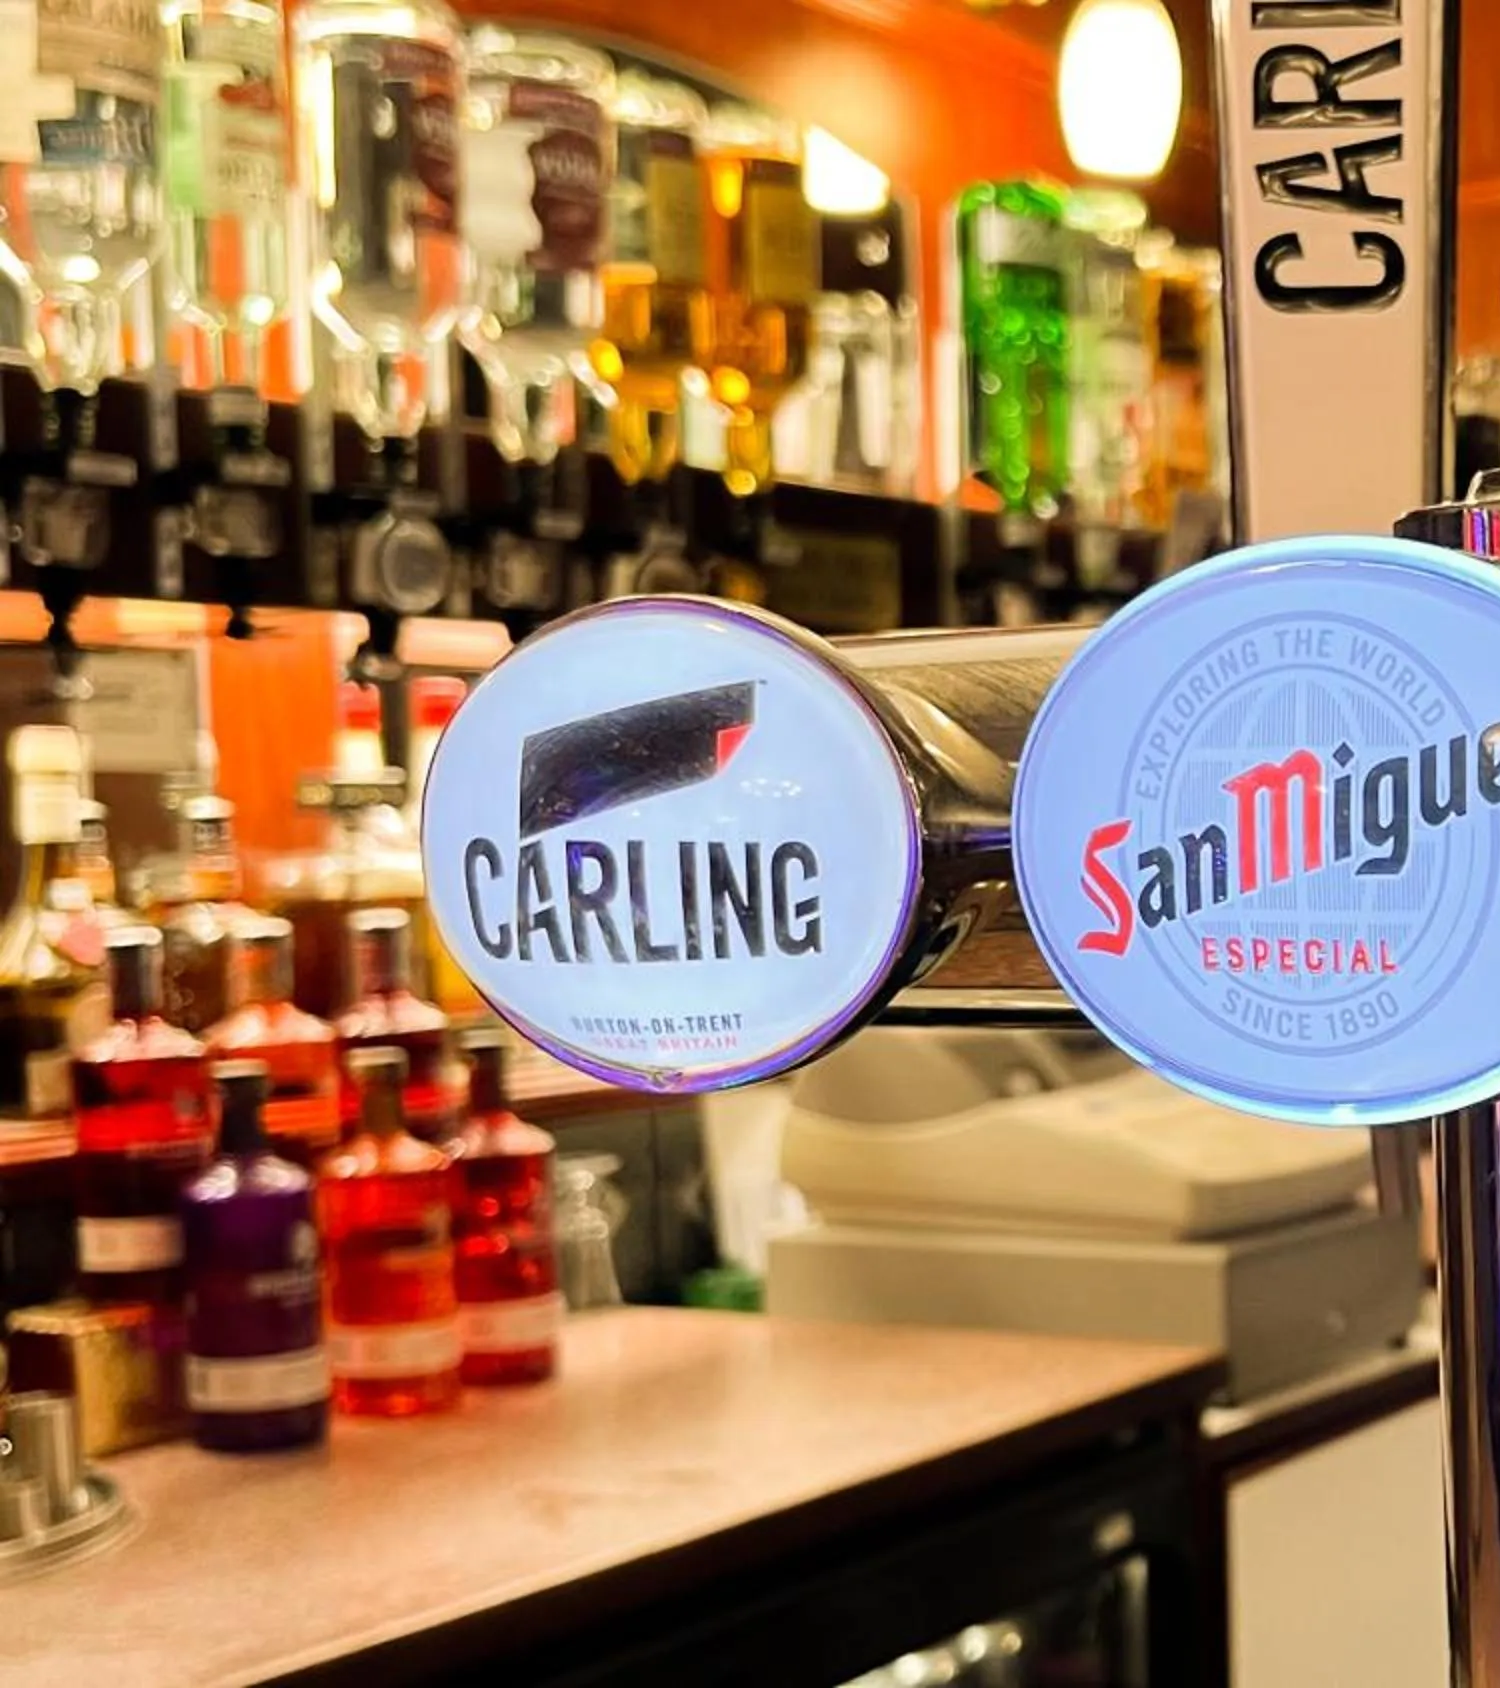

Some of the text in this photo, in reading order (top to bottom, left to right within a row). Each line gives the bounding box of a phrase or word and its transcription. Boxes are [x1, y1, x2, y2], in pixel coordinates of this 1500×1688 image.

[1135, 628, 1447, 801] EXPLORING THE WORLD
[464, 835, 823, 964] CARLING
[1201, 936, 1400, 975] ESPECIAL
[1221, 987, 1400, 1041] SINCE 1890
